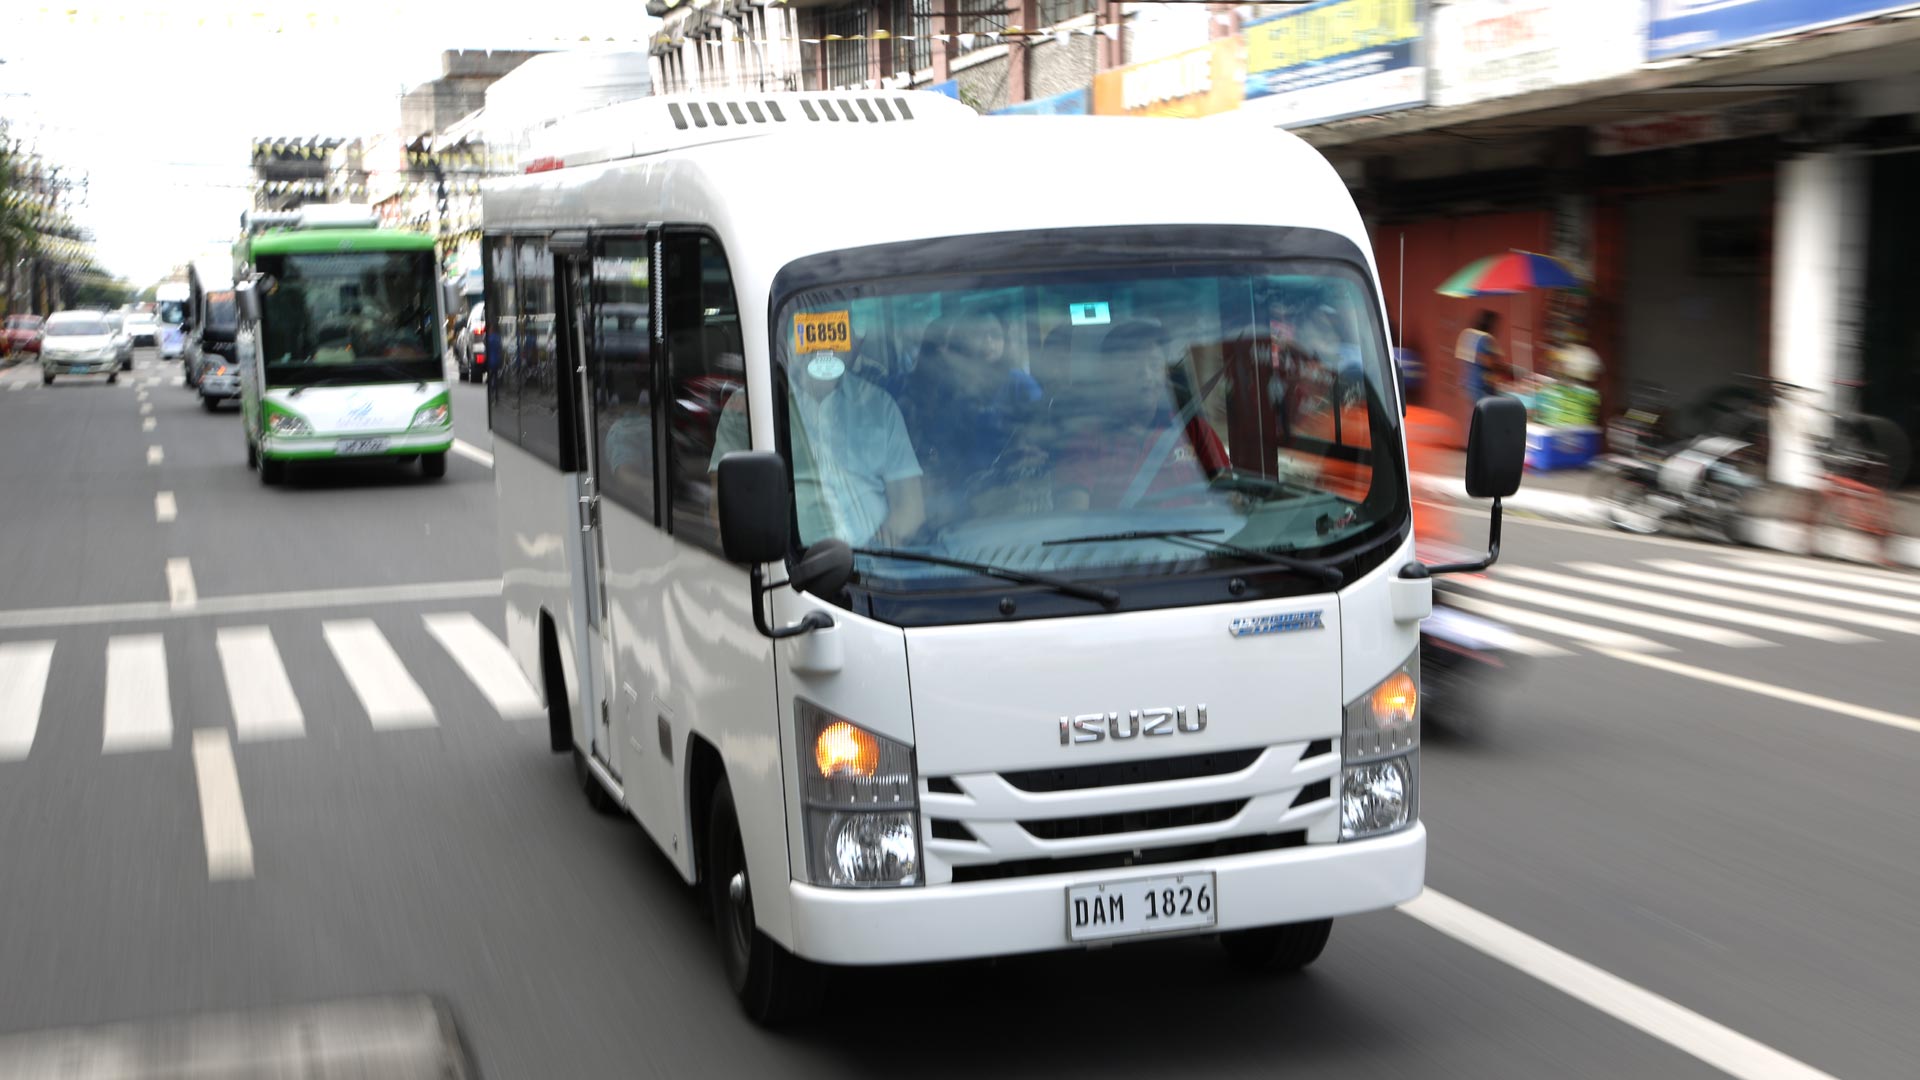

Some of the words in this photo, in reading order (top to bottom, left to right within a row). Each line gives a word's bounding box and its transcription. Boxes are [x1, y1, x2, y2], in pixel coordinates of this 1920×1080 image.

[806, 322, 847, 343] G859
[1058, 703, 1208, 745] ISUZU
[1074, 893, 1125, 928] DAM
[1144, 885, 1212, 920] 1826
